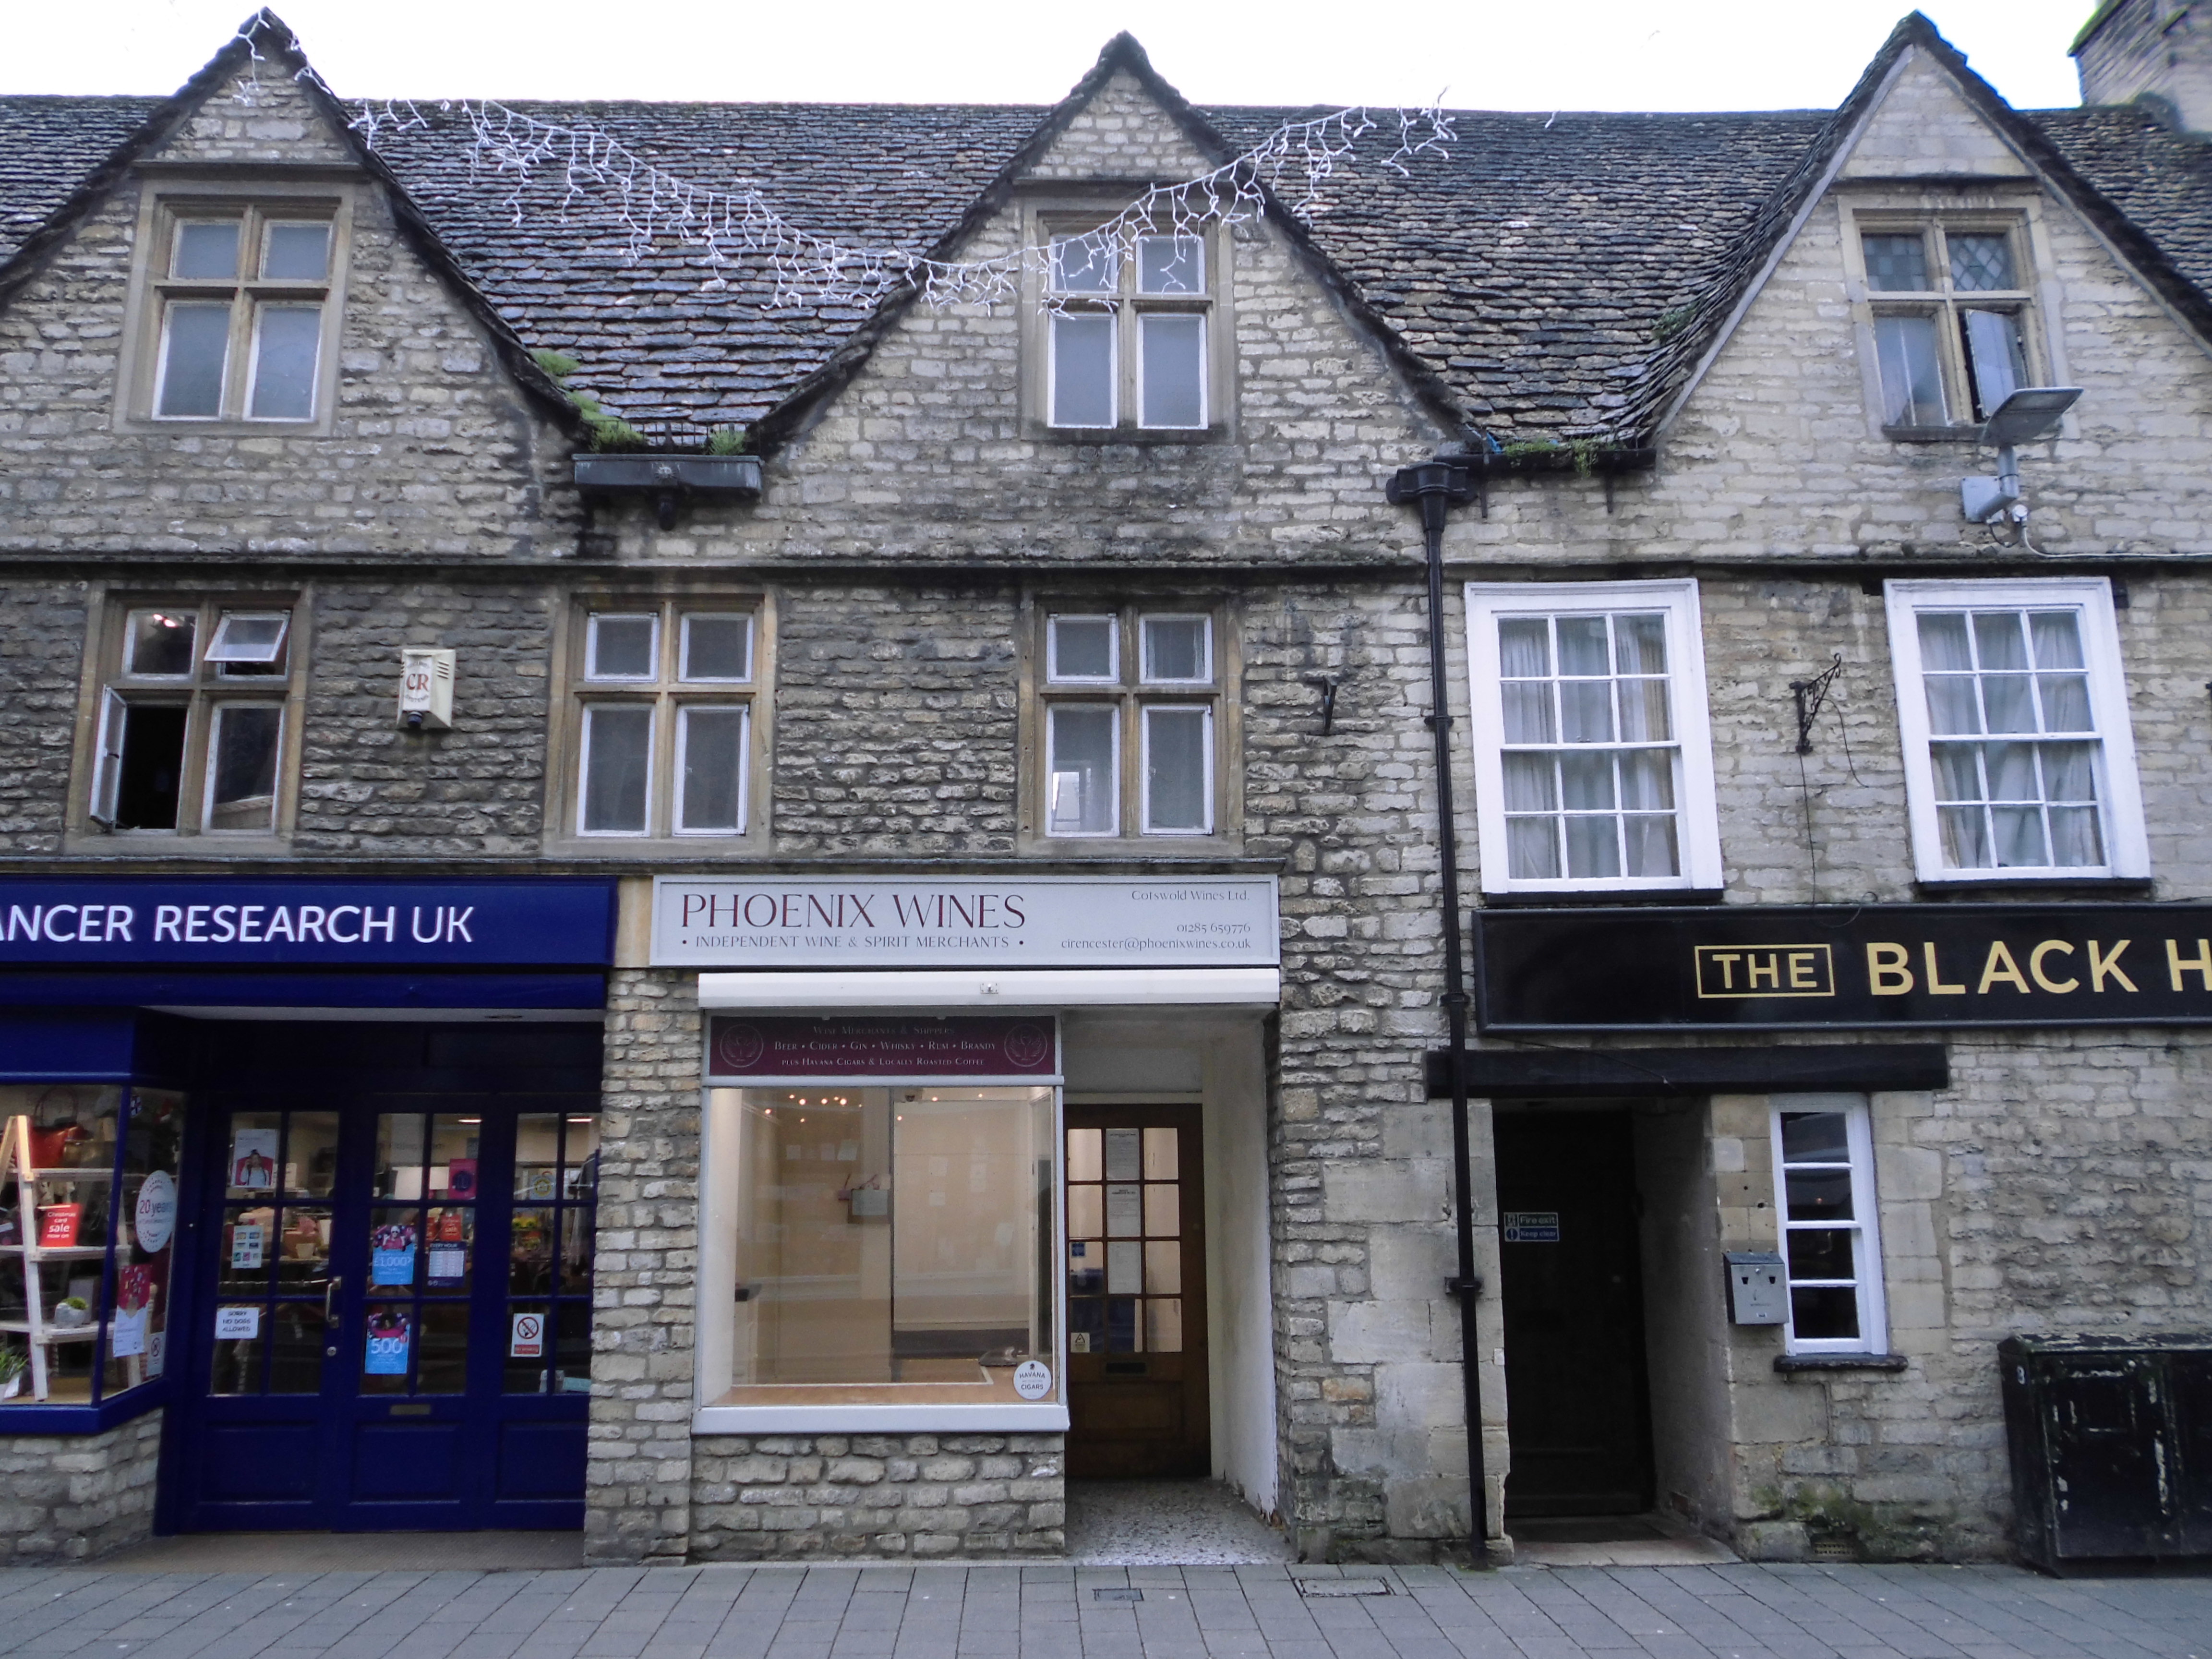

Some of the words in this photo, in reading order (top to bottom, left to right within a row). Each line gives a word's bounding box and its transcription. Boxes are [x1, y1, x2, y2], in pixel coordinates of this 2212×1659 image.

[406, 673, 429, 692] CR
[1131, 890, 1186, 901] Cotswold
[1190, 890, 1225, 901] Wines
[1228, 890, 1250, 901] Ltd.
[682, 894, 875, 927] PHOENIX
[892, 894, 1025, 928] WINES
[0, 904, 133, 942] NCER
[154, 904, 395, 942] RESEARCH
[413, 906, 474, 943] UK
[1177, 923, 1207, 933] 01285
[1211, 922, 1251, 934] 659776
[696, 936, 799, 948] INDEPENDENT
[805, 936, 842, 948] WINE
[848, 937, 858, 948] &
[865, 937, 911, 948] SPIRIT
[916, 937, 1009, 948] MERCHANTS
[1061, 937, 1251, 951] cirencester@phoenixwines.co.uk
[1712, 953, 1817, 989] THE
[1866, 939, 2140, 995] BLACK
[2165, 938, 2212, 992] H
[868, 1058, 875, 1066] &
[139, 1200, 151, 1214] 20
[1538, 1215, 1556, 1224] exit
[48, 1223, 70, 1233] sale
[371, 1337, 403, 1354] 500
